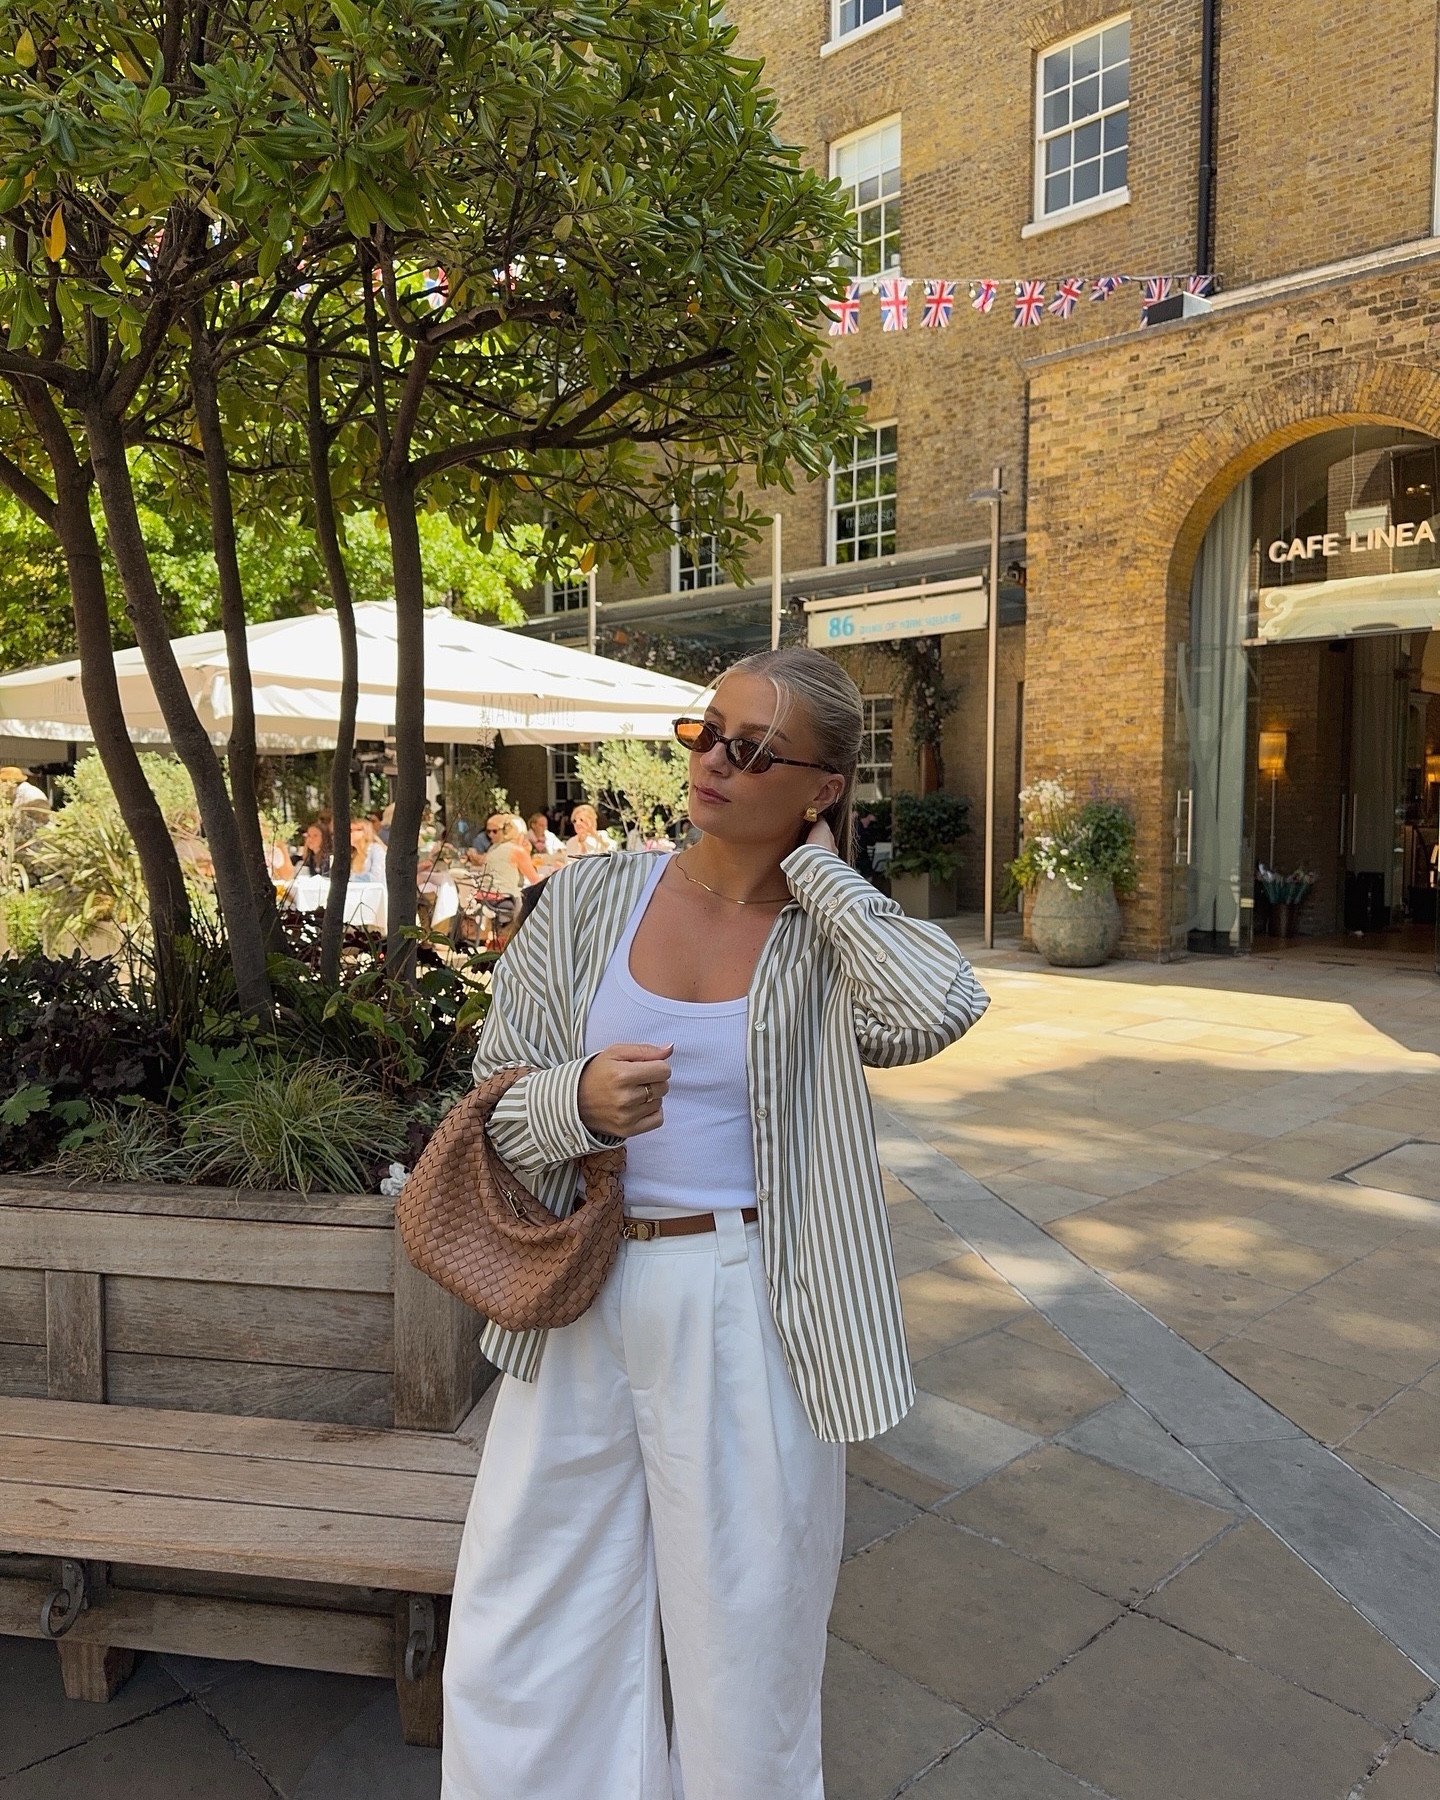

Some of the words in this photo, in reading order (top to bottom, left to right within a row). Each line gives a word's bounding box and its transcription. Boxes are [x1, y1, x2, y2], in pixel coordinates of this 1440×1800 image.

[1268, 533, 1341, 563] CAFE
[1350, 520, 1436, 553] LINEA
[829, 615, 855, 638] 86
